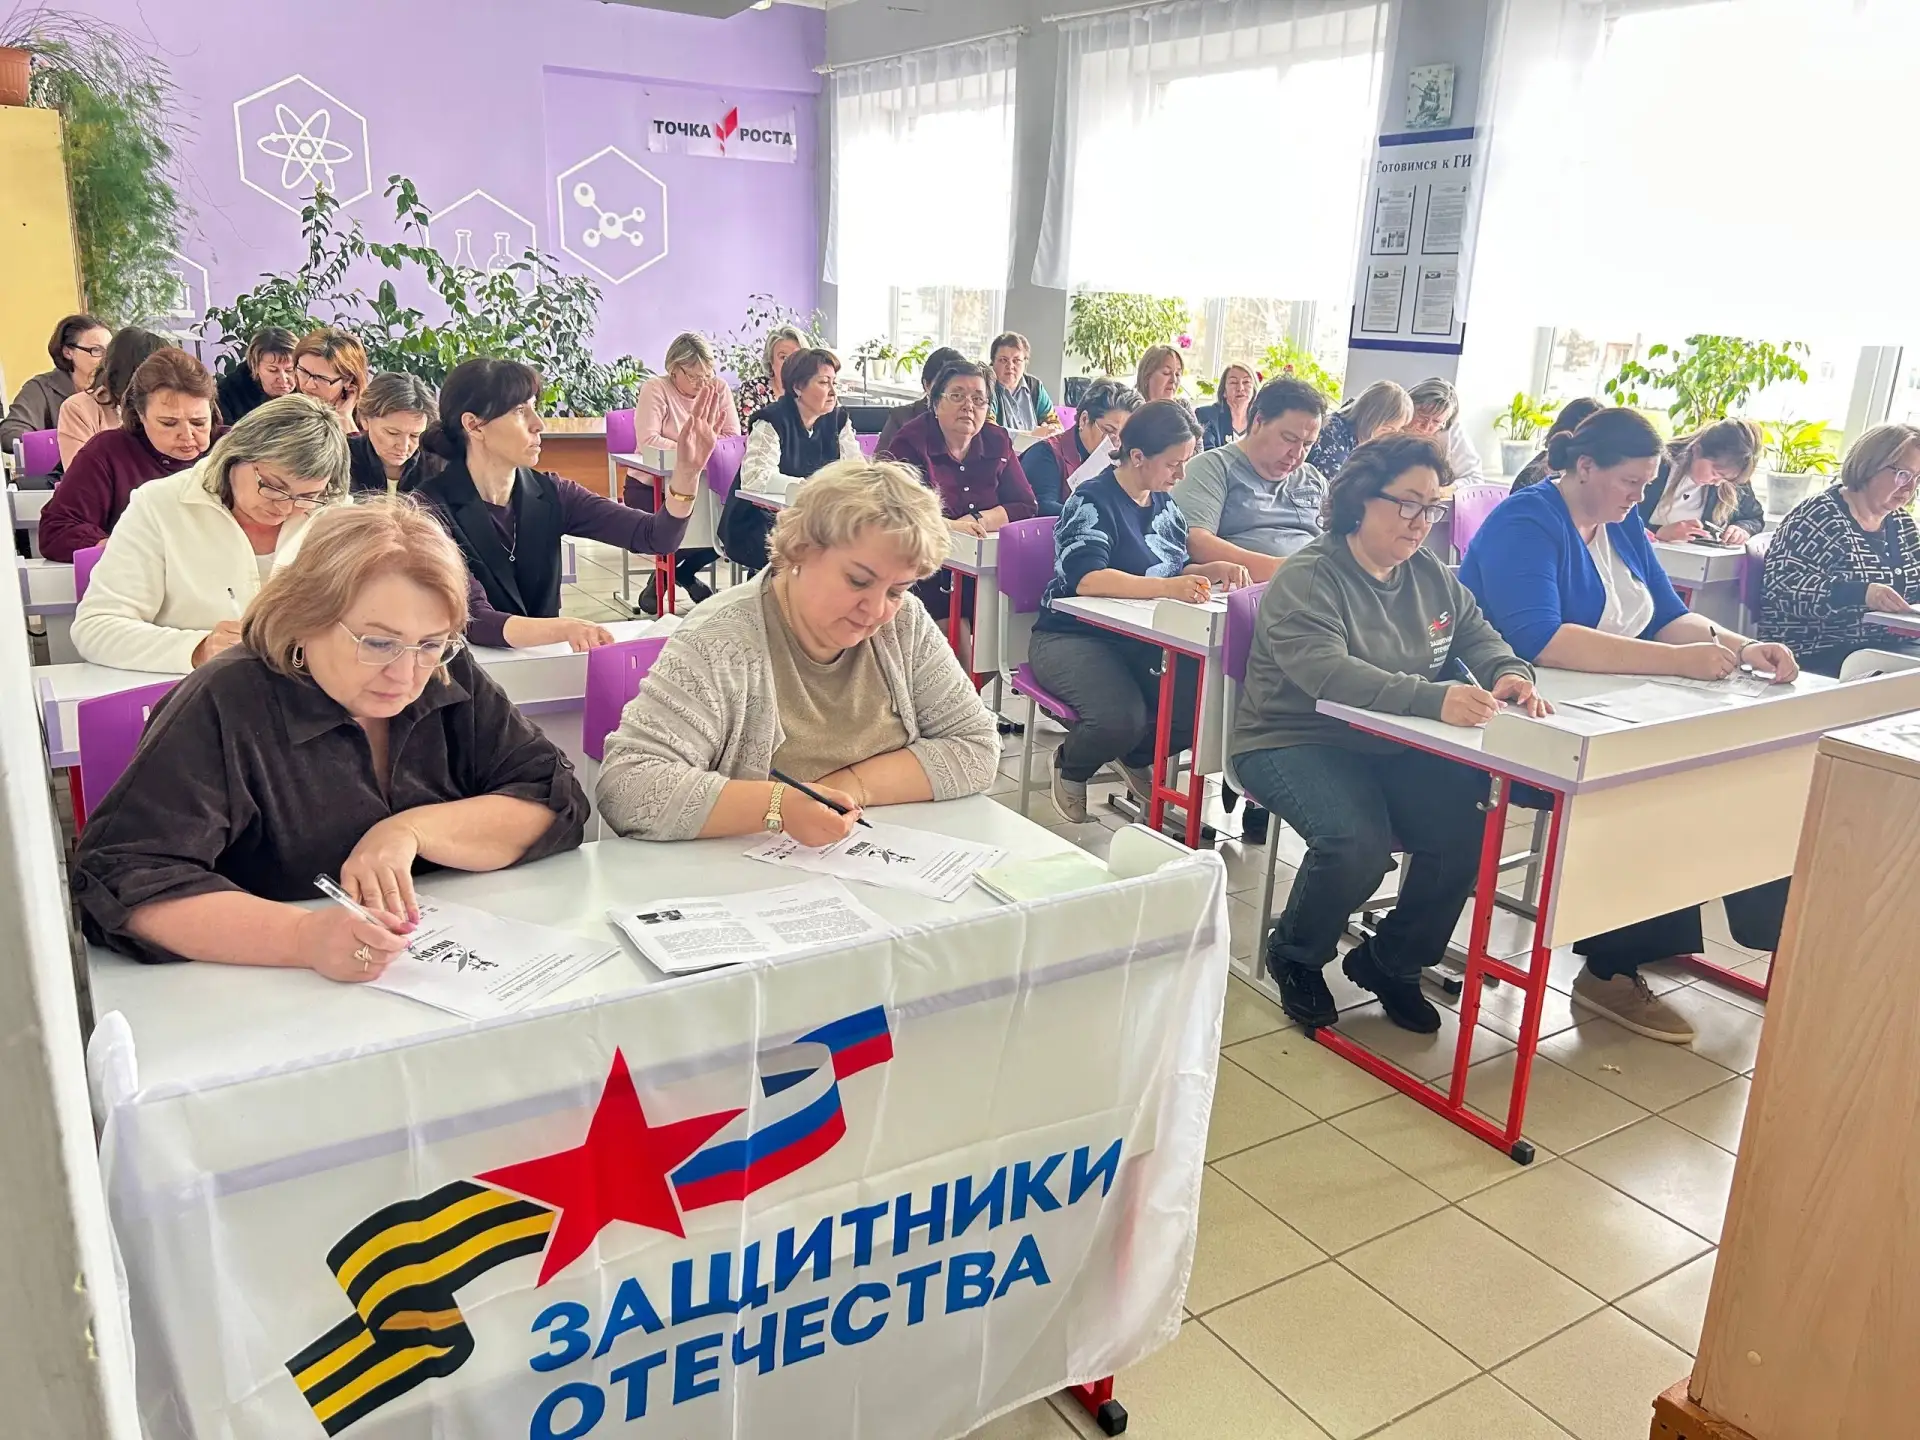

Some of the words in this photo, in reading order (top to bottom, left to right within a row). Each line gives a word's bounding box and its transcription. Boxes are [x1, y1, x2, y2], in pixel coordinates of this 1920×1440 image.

[653, 120, 711, 138] ТОЧКА
[739, 128, 793, 145] РОСТА
[1376, 160, 1437, 173] Готовимся
[1442, 159, 1449, 169] к
[1453, 154, 1472, 168] ГИ
[529, 1138, 1123, 1372] ЗАЩИТНИКИ
[530, 1233, 1052, 1440] ОТЕЧЕСТВА
